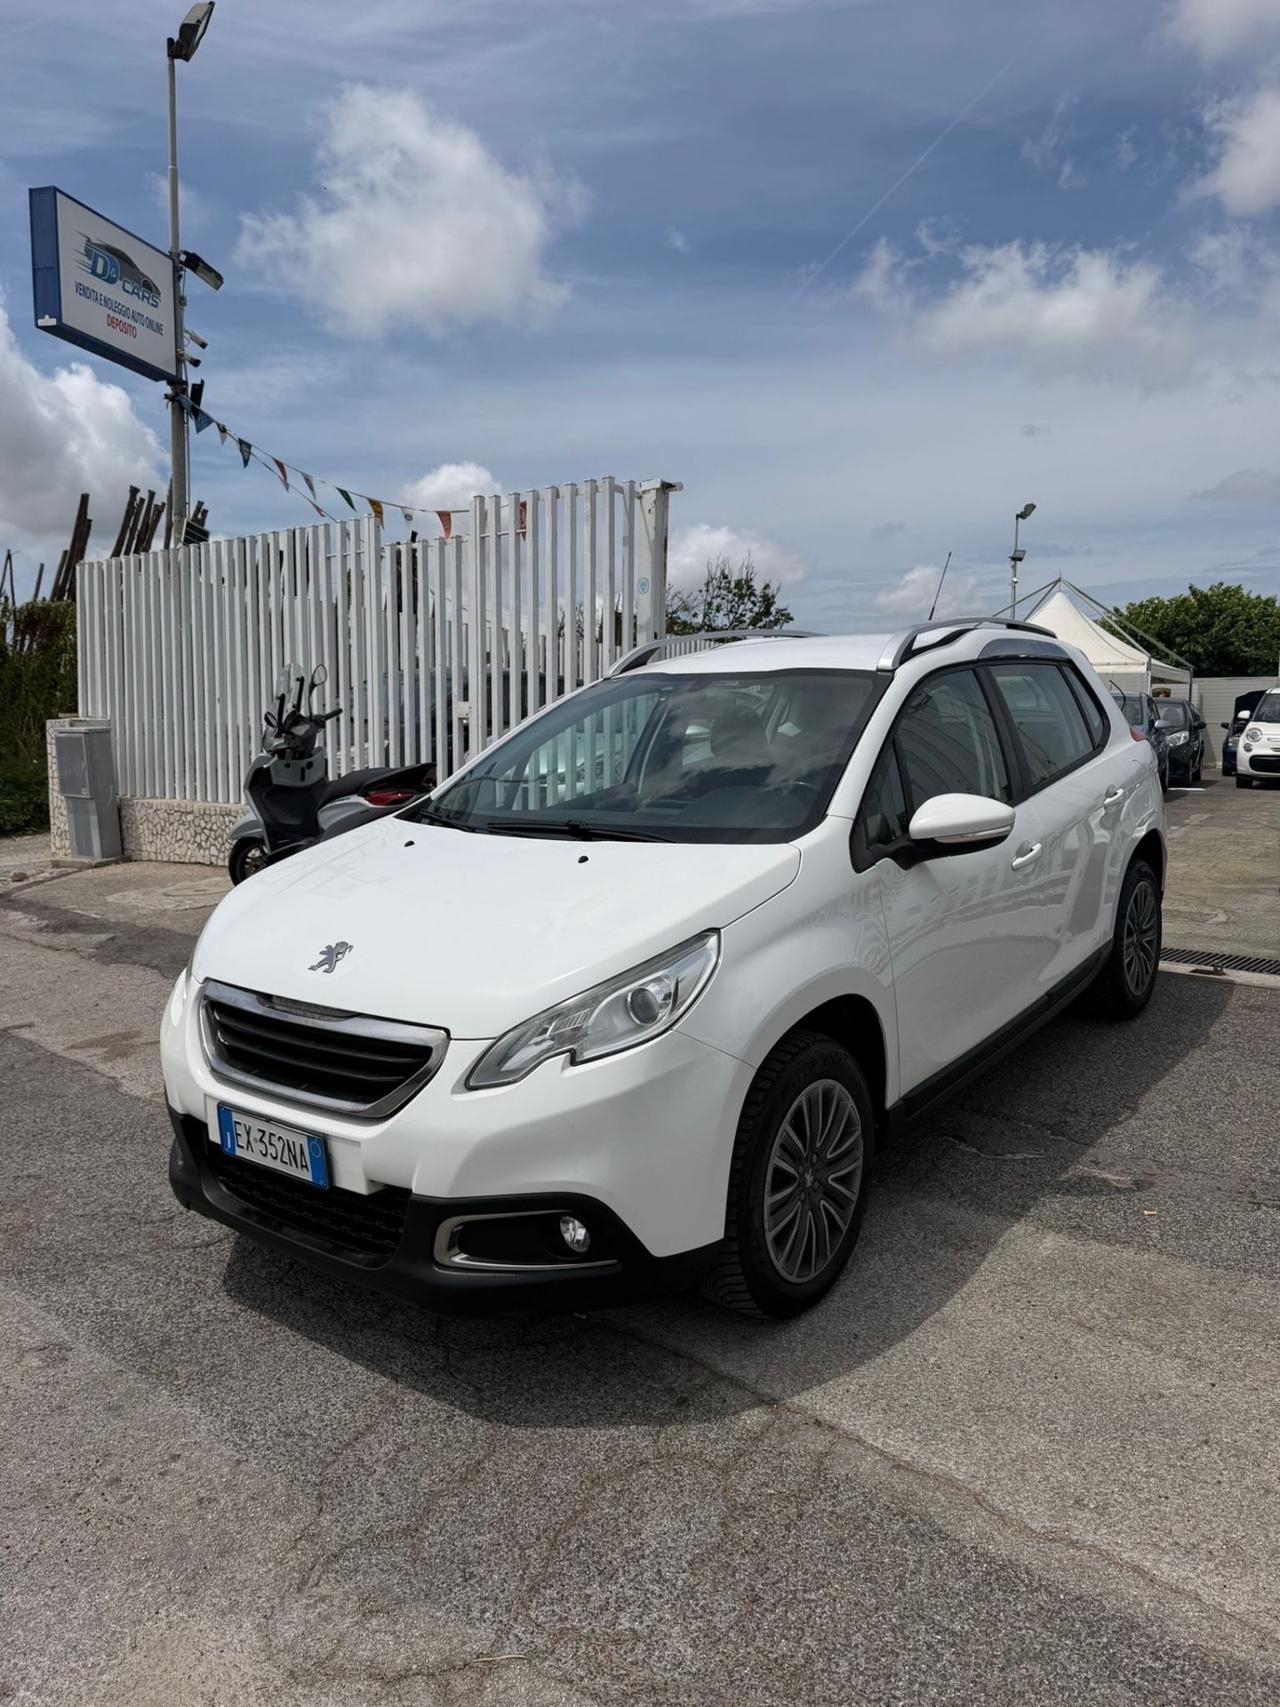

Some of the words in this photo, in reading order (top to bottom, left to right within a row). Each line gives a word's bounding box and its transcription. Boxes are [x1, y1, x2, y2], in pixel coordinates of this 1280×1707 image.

[74, 280, 99, 305] VENDITA
[103, 295, 131, 320] NOLEGGIO
[131, 309, 145, 327] AUTO
[145, 317, 164, 336] ONLINE
[122, 278, 161, 309] CARS
[107, 314, 137, 339] DEPOSITO
[233, 1120, 254, 1154] EX
[257, 1128, 310, 1172] 352NA
